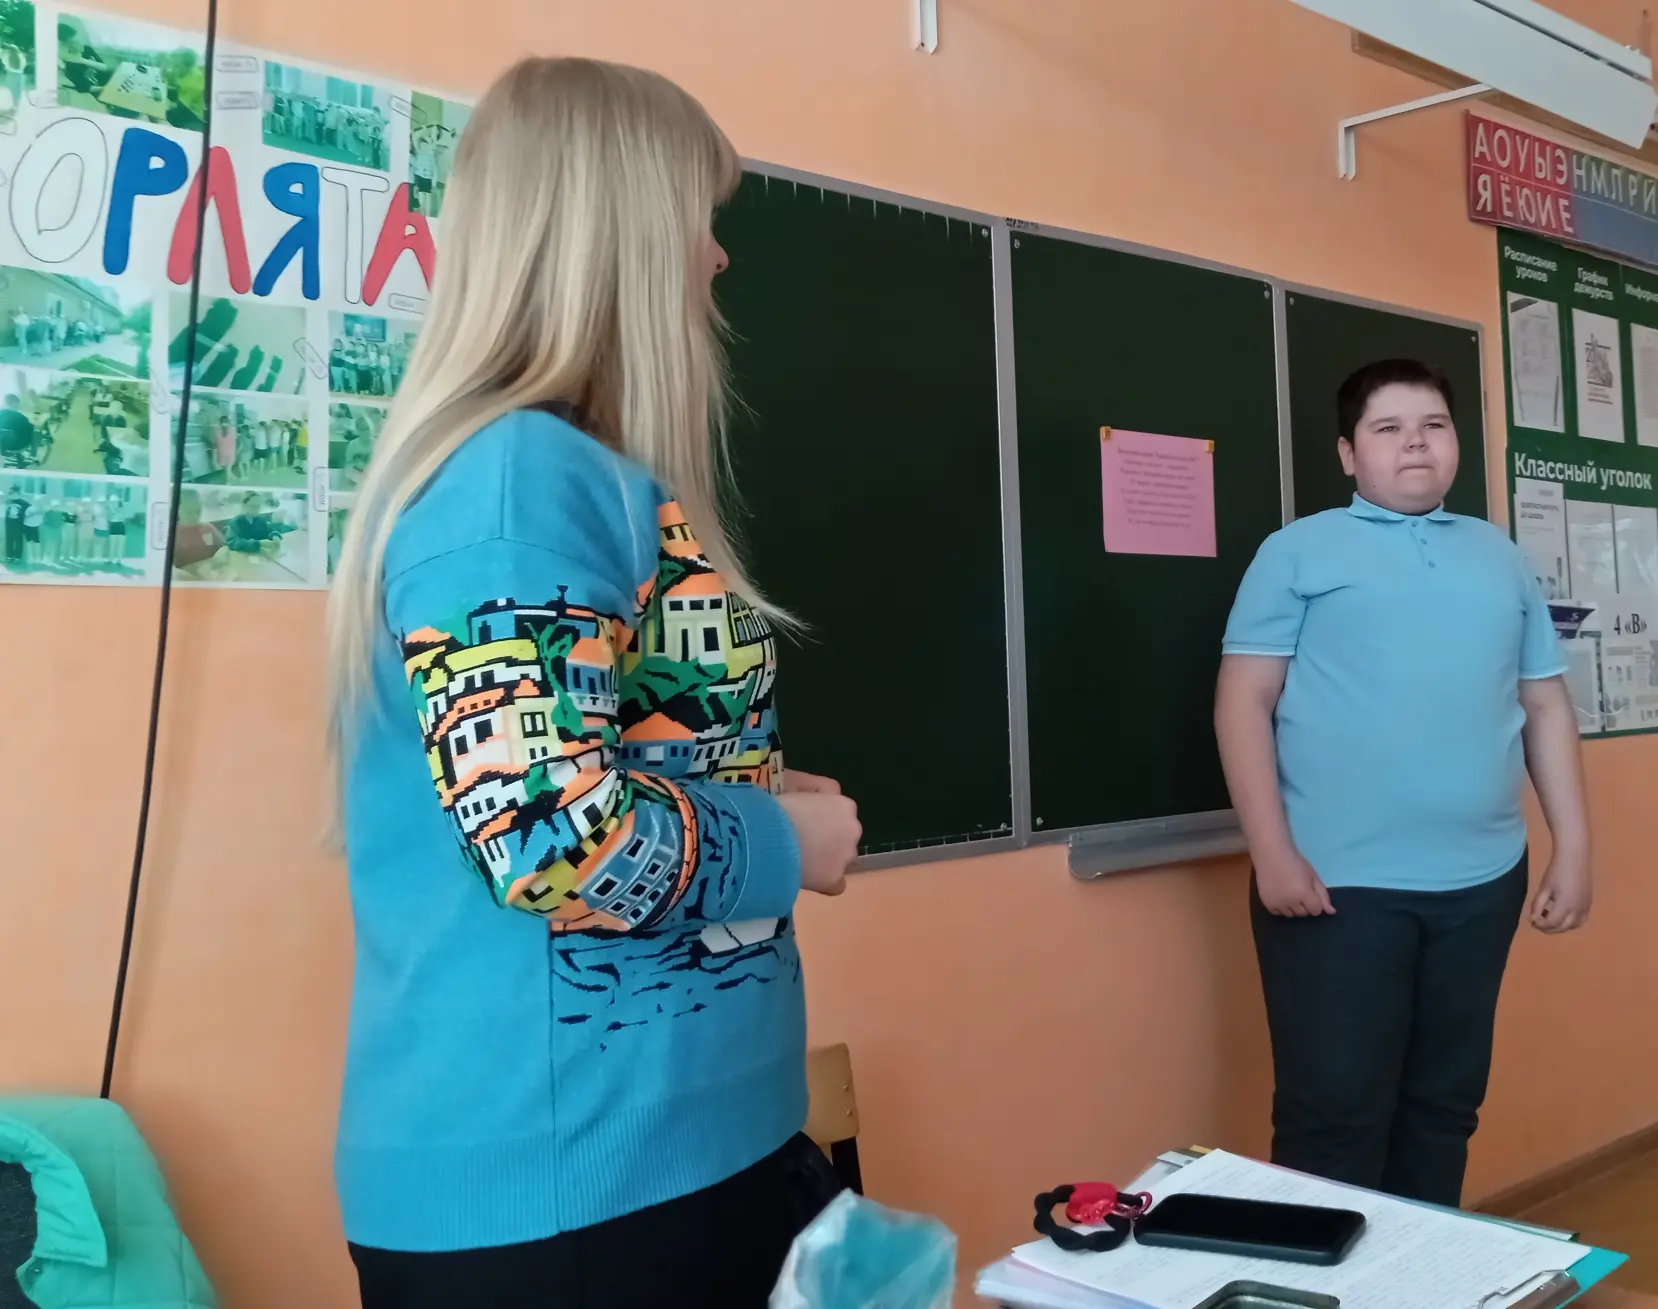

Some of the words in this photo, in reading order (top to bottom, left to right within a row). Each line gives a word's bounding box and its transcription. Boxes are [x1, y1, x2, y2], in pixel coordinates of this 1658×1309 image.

[9, 117, 437, 306] ОРЛЯТА
[1504, 246, 1557, 272] Расписание
[1516, 265, 1548, 283] уроков
[1577, 267, 1609, 287] График
[1514, 452, 1597, 485] Классный
[1600, 467, 1653, 491] уголок
[1613, 614, 1621, 636] 4
